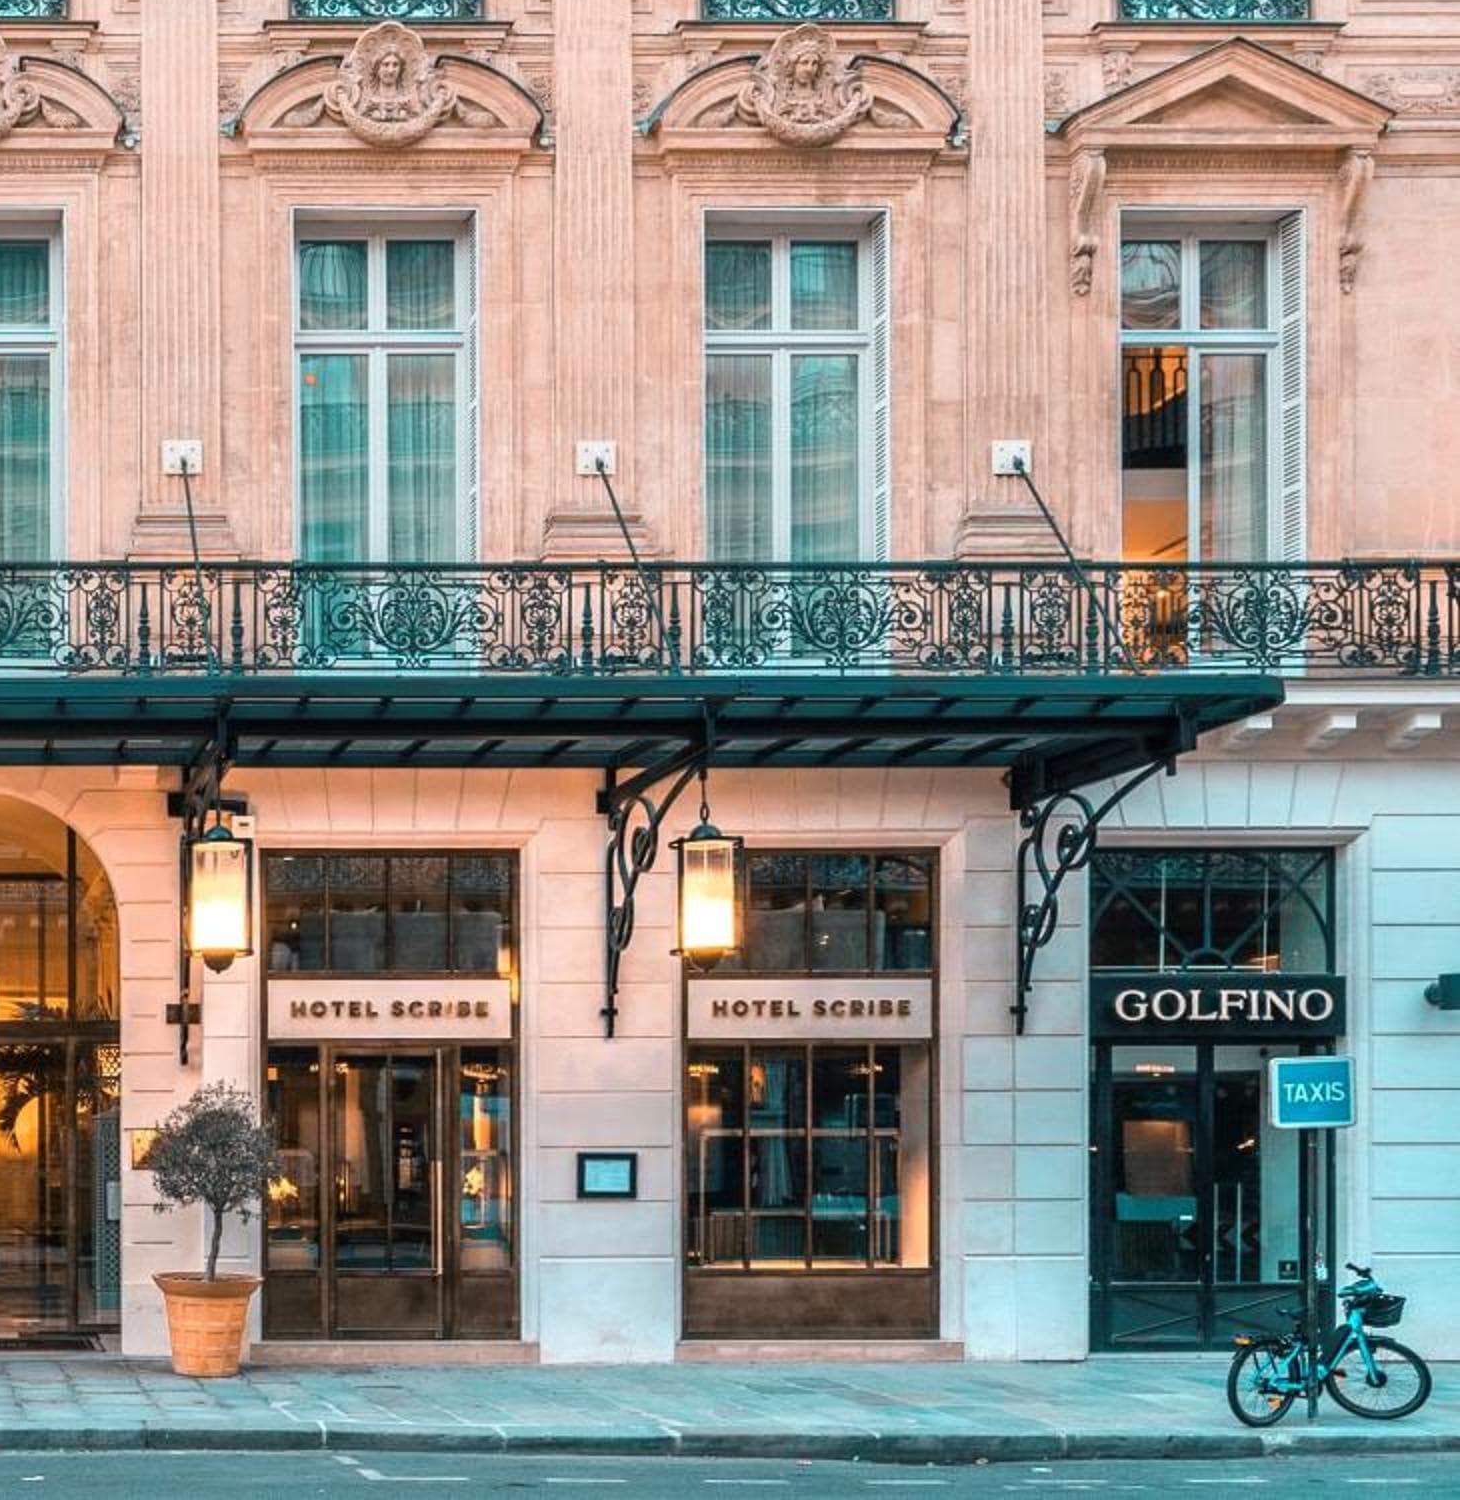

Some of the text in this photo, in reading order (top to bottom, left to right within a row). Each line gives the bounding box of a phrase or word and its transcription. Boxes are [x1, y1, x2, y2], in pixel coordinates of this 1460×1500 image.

[290, 1001, 490, 1018] HOTEL SCRIBE
[712, 1000, 911, 1018] HOTEL SCRIBE
[1114, 989, 1335, 1022] GOLFINO
[1283, 1081, 1346, 1104] TAXIS
